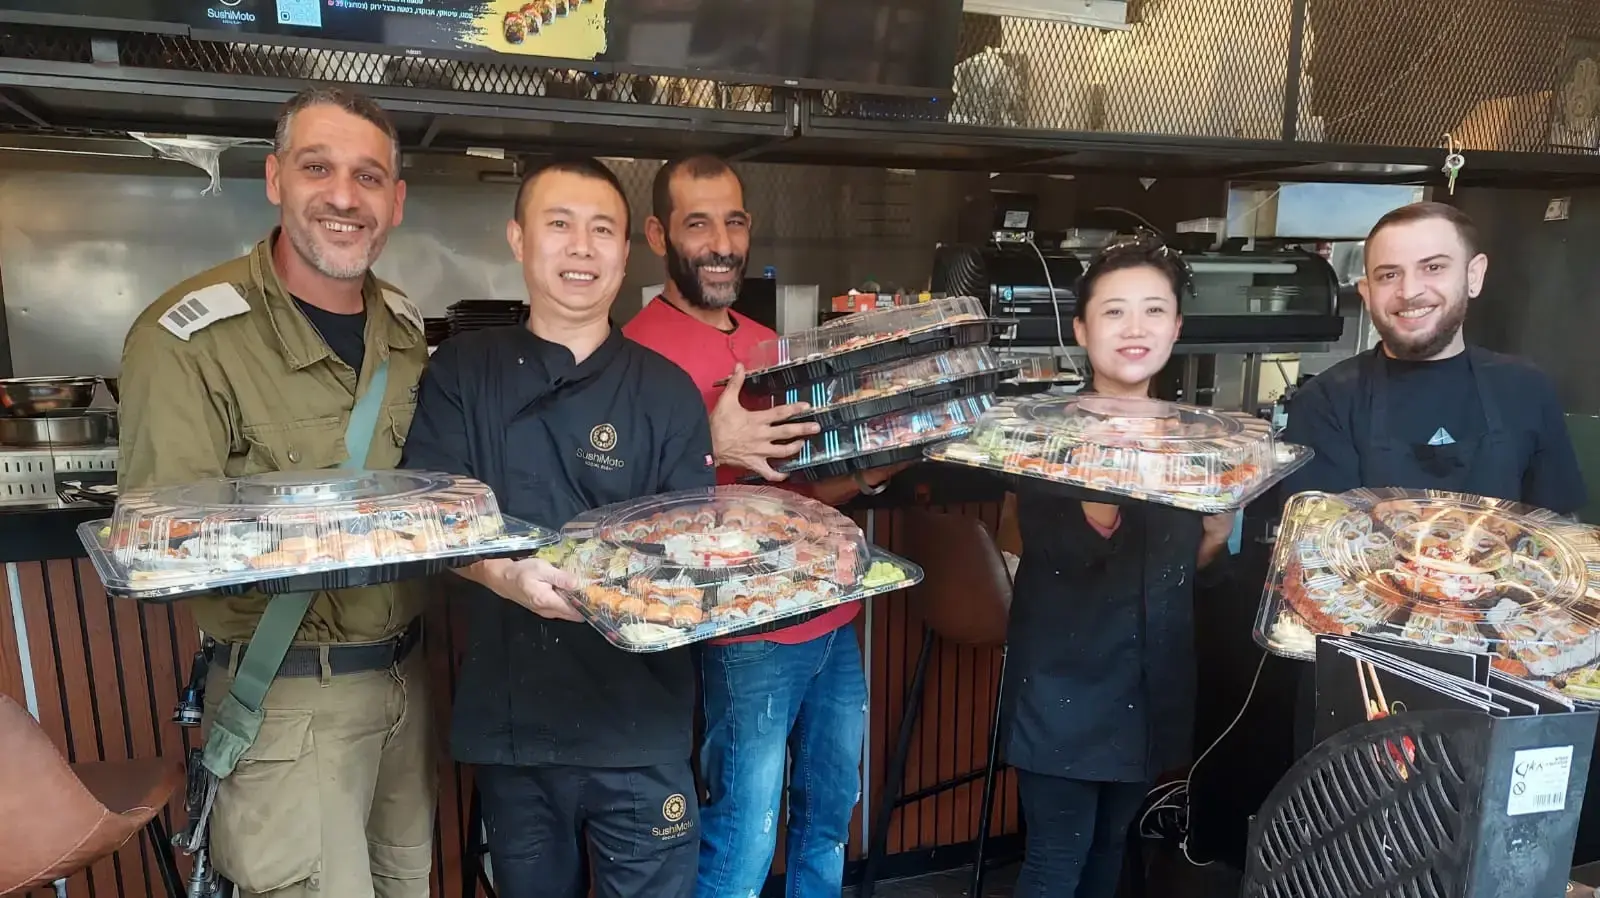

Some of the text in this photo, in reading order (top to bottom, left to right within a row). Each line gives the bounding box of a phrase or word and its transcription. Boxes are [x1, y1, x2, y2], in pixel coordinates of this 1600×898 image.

[207, 8, 256, 21] SushiMoto
[576, 448, 624, 467] SushiMoto
[652, 819, 693, 836] SushiMoto
